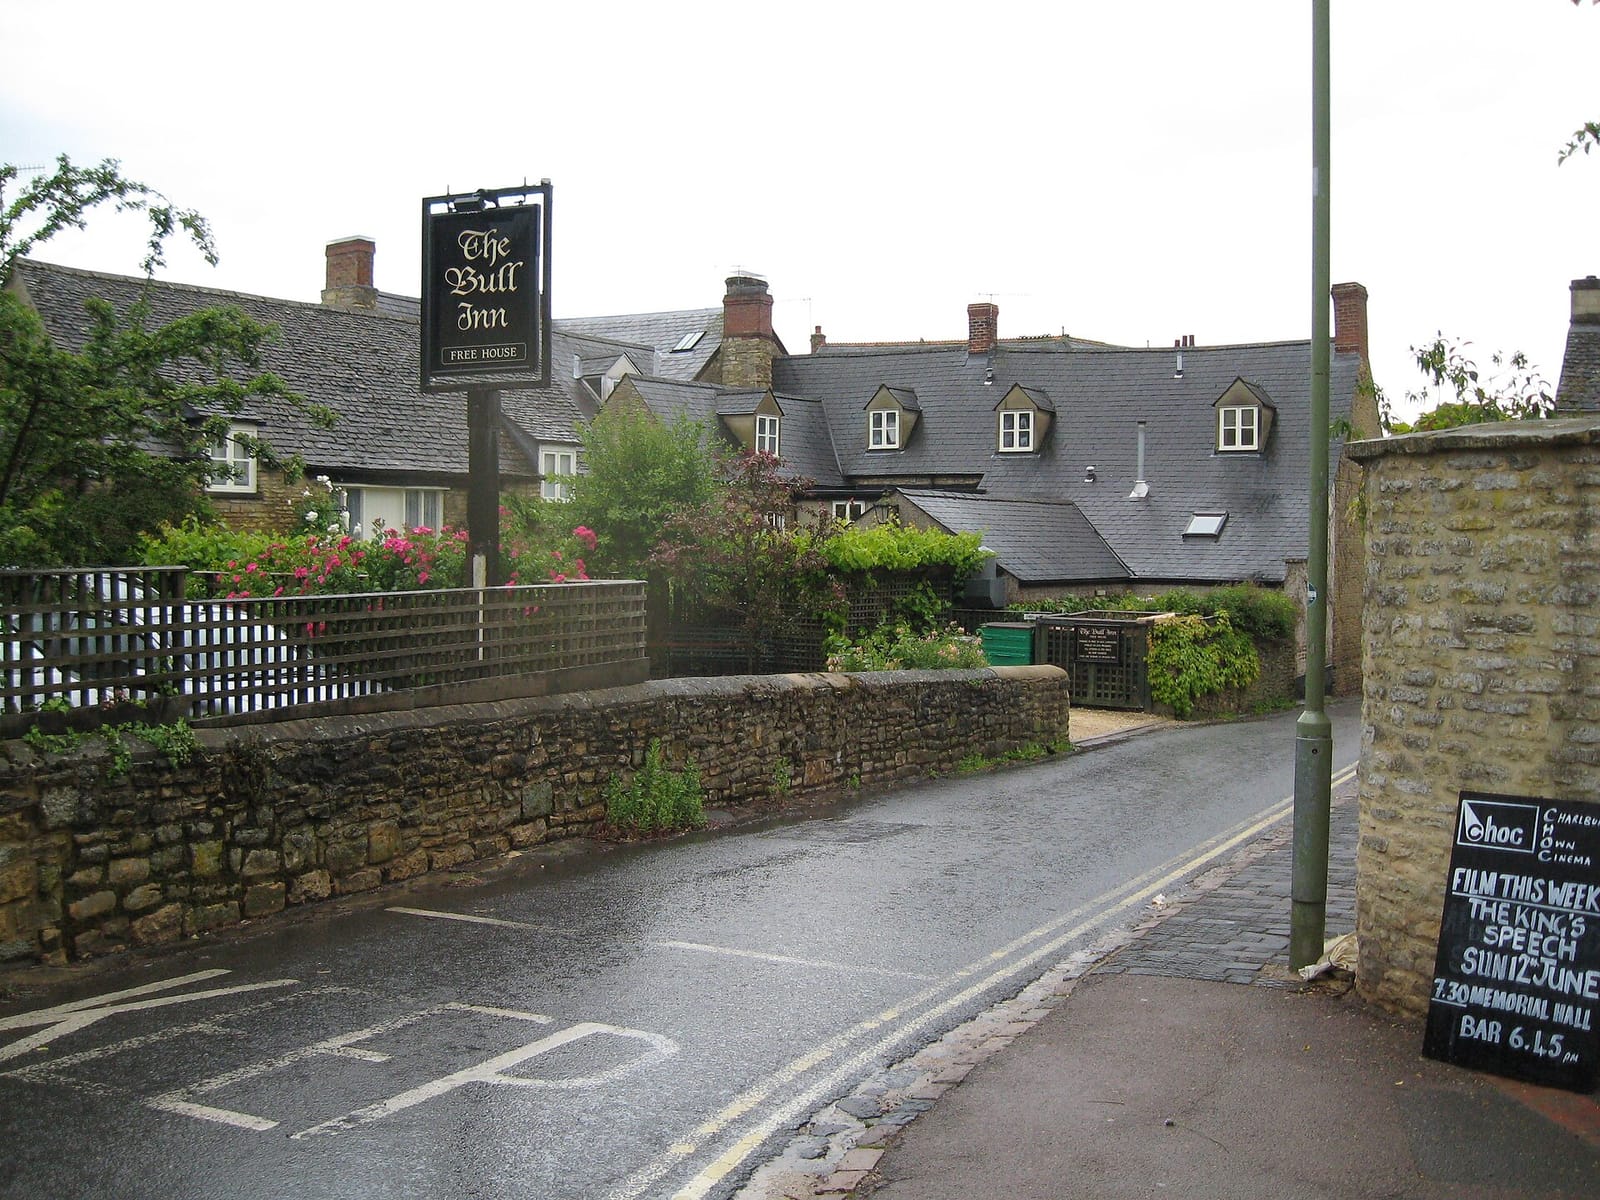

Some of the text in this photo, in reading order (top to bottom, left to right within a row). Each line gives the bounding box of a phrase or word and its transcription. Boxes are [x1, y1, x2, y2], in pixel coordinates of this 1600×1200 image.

[458, 228, 511, 267] The
[444, 261, 524, 296] Bull
[457, 302, 509, 331] Inn
[450, 347, 517, 361] FREE HOUSE
[1537, 849, 1591, 867] CINEMA
[1452, 867, 1600, 912] FILM THIS WEEK
[1468, 897, 1586, 939] THE KING'S
[1482, 925, 1577, 962] SPEECH
[1460, 946, 1508, 981] SUN
[1532, 956, 1600, 1000] JUNE
[1433, 978, 1592, 1032] 7.30 MEMORIAL HALL
[1459, 1014, 1502, 1044] BAR
[1509, 1026, 1565, 1057] 6.45
